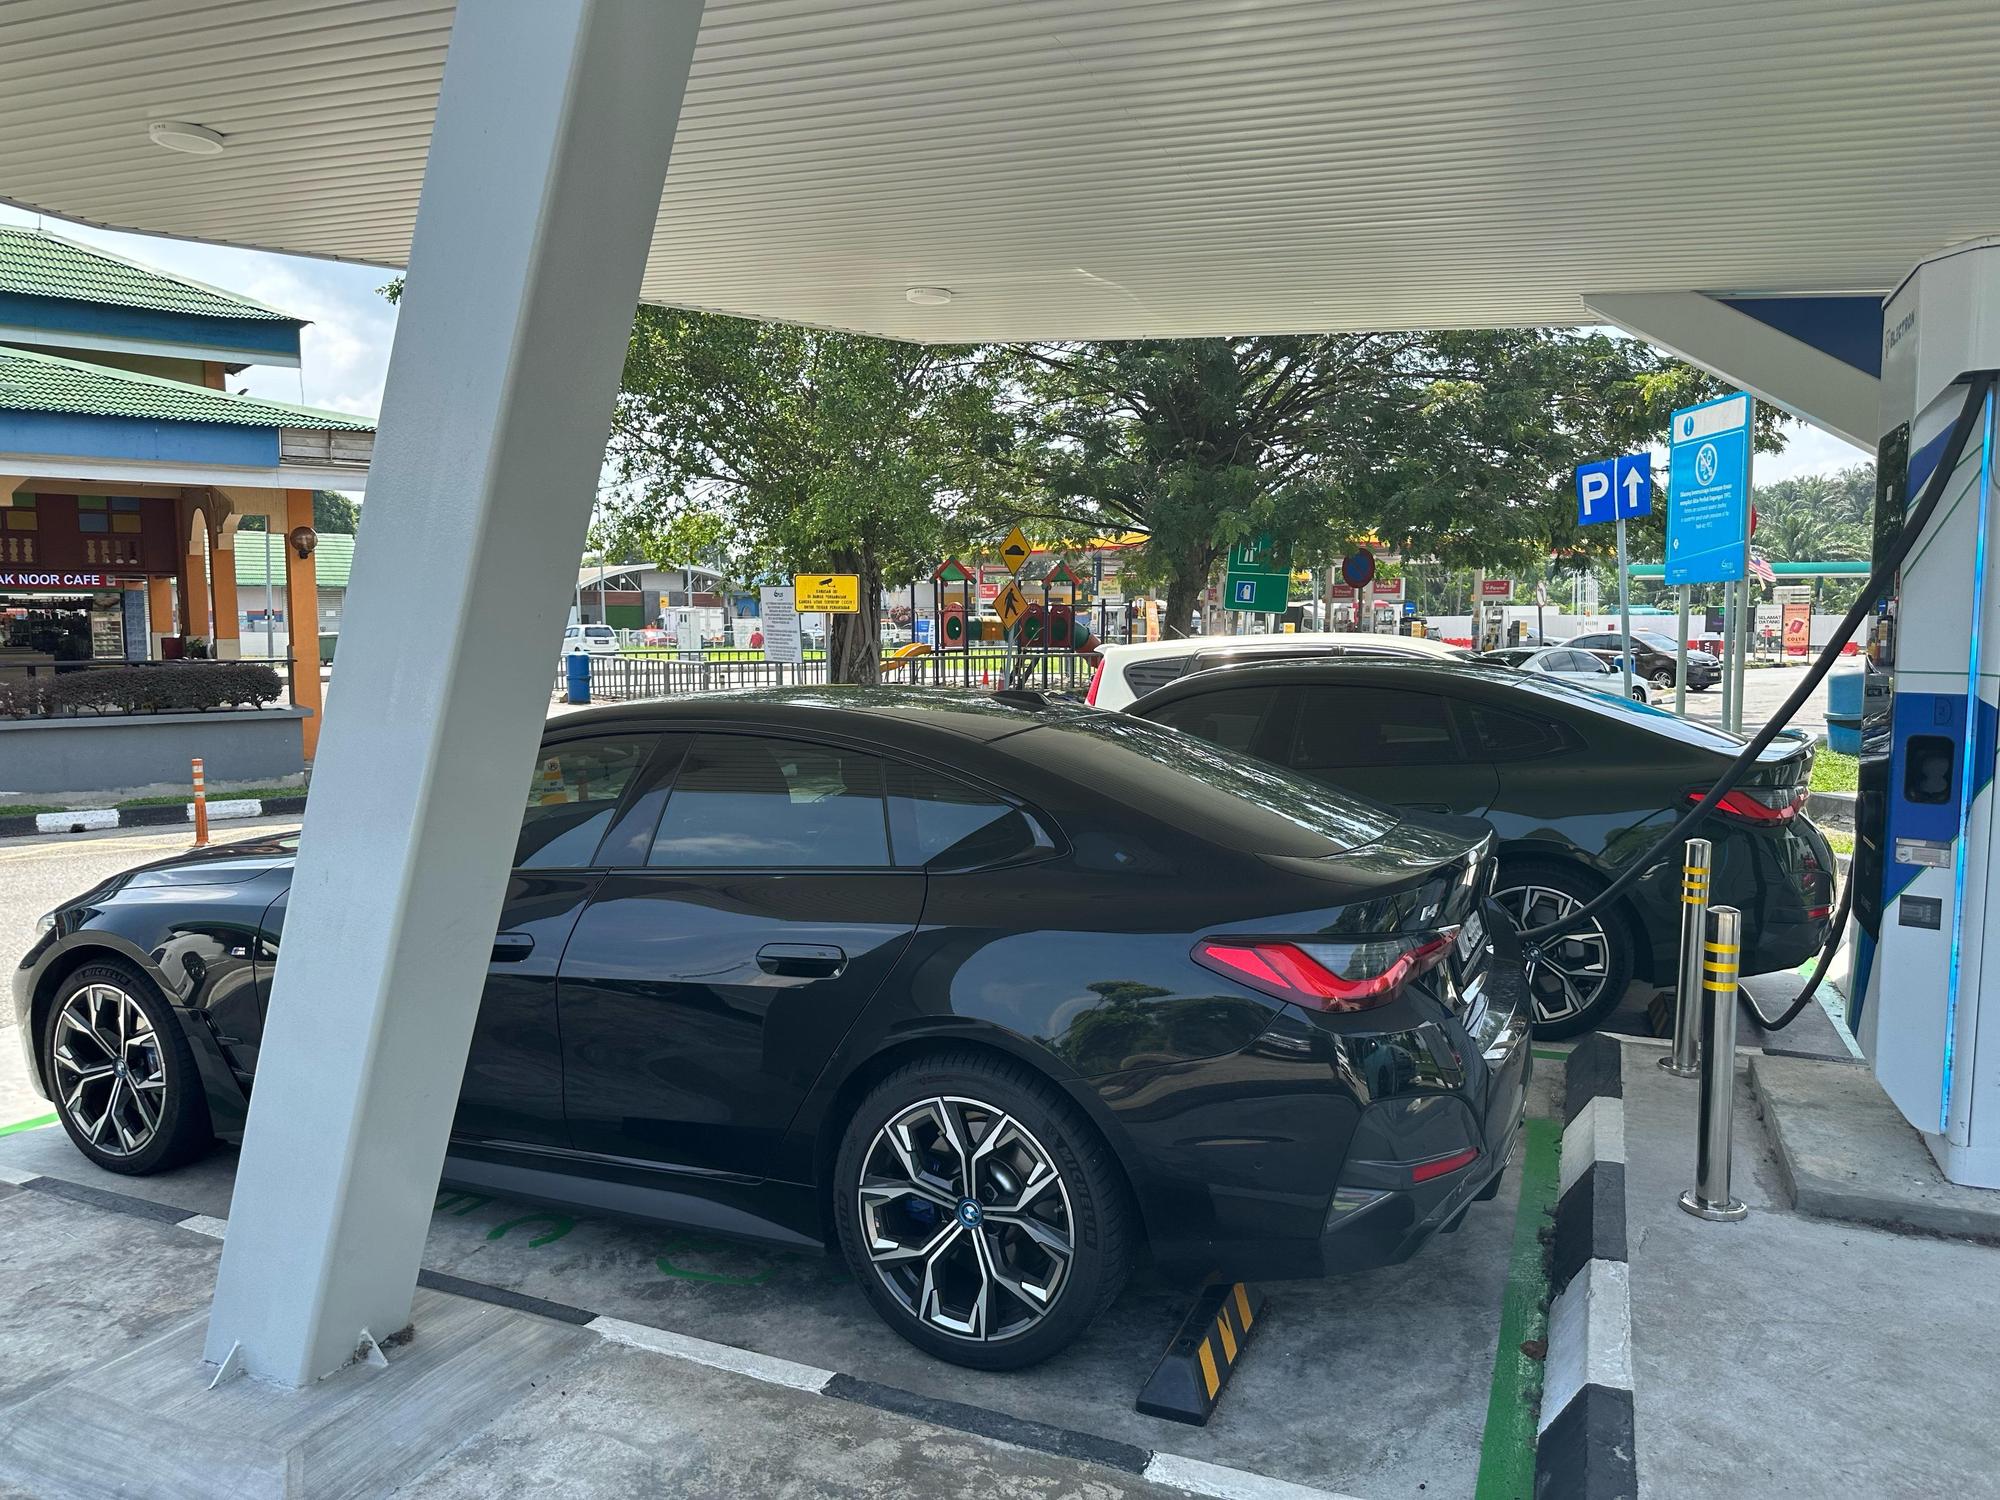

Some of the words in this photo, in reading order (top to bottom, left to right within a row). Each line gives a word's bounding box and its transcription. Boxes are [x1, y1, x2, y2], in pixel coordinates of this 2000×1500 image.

[1581, 472, 1609, 516] P
[19, 574, 59, 585] NOOR
[64, 574, 101, 585] CAFE
[82, 967, 131, 985] MICHELIN
[1058, 1145, 1098, 1251] MICHELIN
